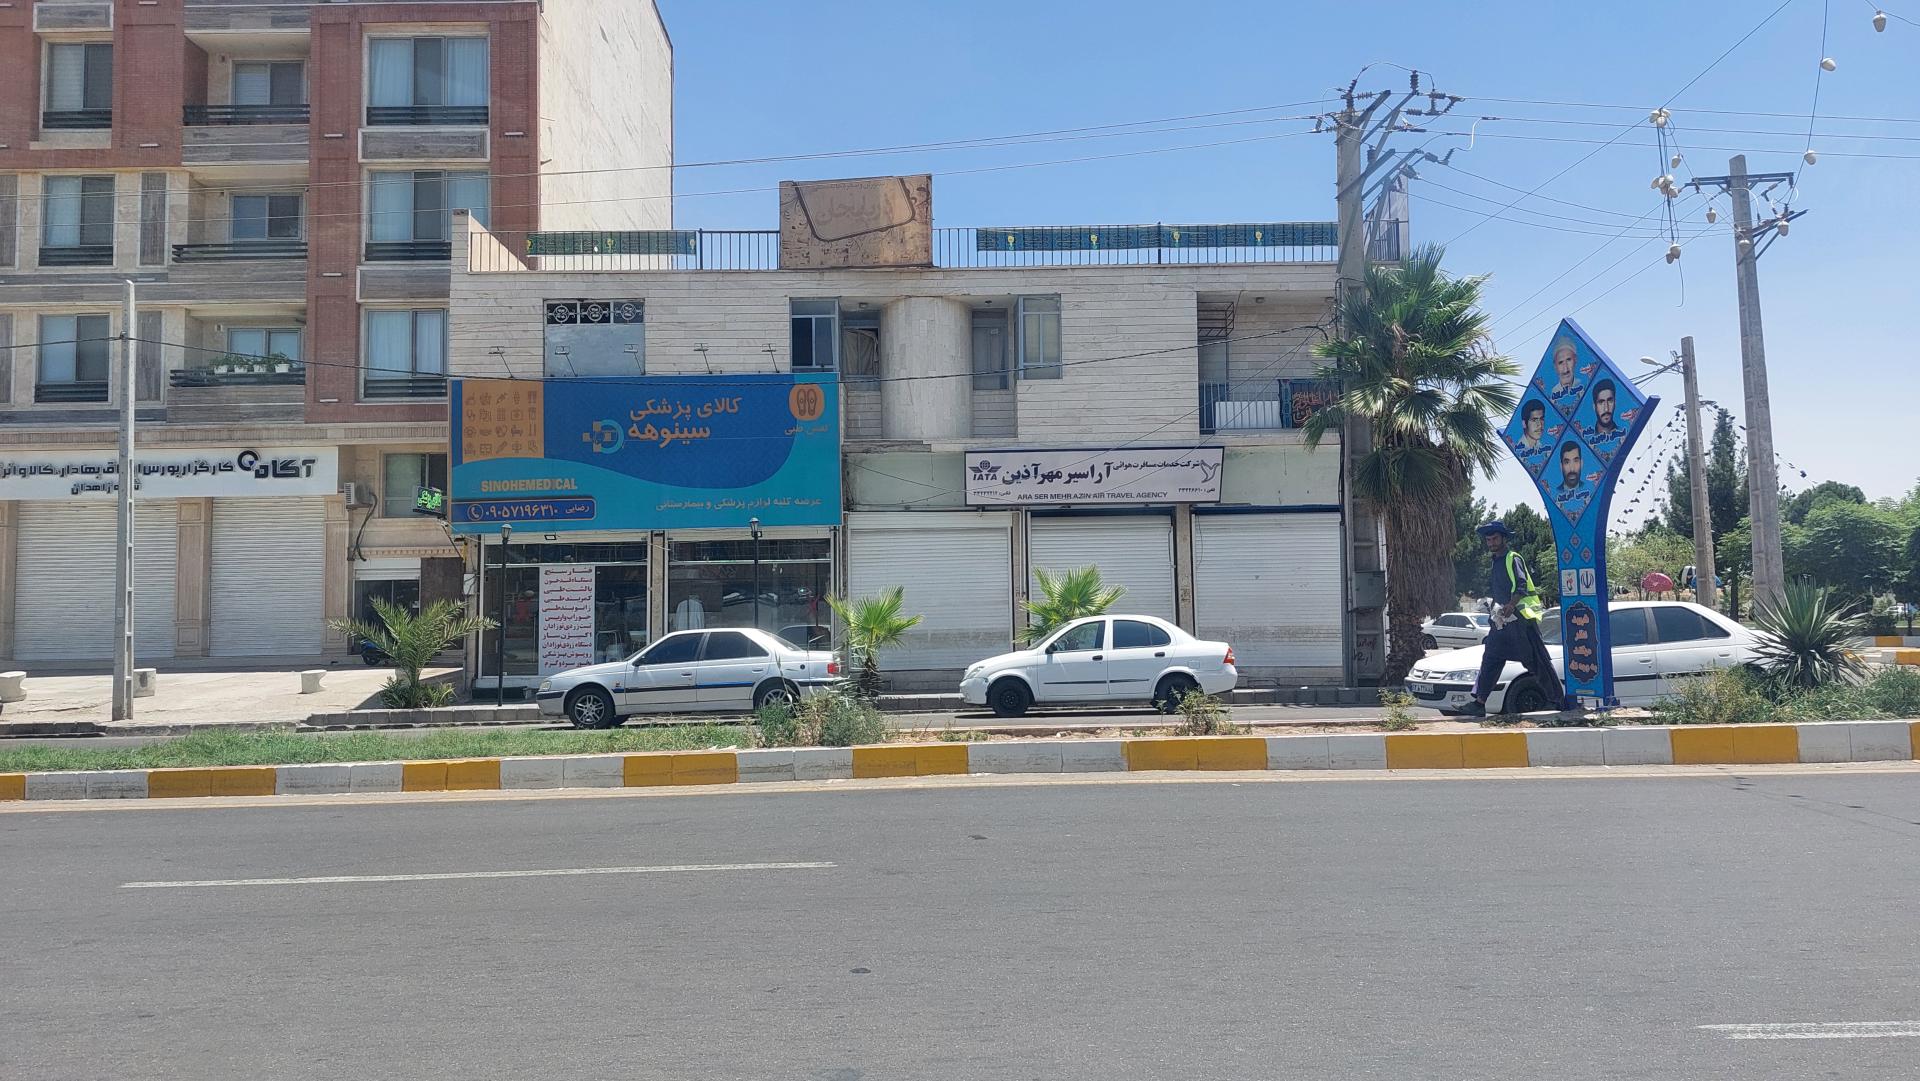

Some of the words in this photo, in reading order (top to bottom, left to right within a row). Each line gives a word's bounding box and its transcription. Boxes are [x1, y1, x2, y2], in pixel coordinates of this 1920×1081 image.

[630, 397, 691, 421] پزشکی
[697, 397, 743, 418] کالای
[628, 423, 710, 449] سینوهه
[29, 464, 54, 476] کالا
[102, 460, 141, 475] ااق
[143, 462, 182, 479] بورس
[254, 458, 316, 479] آگاه
[1133, 460, 1157, 470] مسافرت
[1157, 460, 1180, 470] خدمات
[1180, 459, 1200, 470] شرکت
[973, 473, 997, 481] IATA
[1002, 462, 1042, 485] آذین
[1037, 469, 1063, 485] مهر
[1063, 468, 1089, 485] سیر
[71, 482, 114, 496] زاهدان
[481, 478, 578, 492] SINOHEMEDICAL
[746, 496, 771, 511] لوازم
[773, 496, 792, 506] کلیه
[1017, 494, 1034, 502] ARA
[1035, 493, 1049, 502] SER
[1050, 493, 1072, 501] MEHR
[1072, 492, 1092, 501] AZIN
[1092, 492, 1105, 500] AIR
[1106, 491, 1135, 500] TRAVEL
[1135, 491, 1168, 499] AGENCY
[486, 504, 559, 519] ۰۹۰۵۷۱۹۶۳۱۰
[565, 503, 591, 515] رضایی
[714, 497, 746, 512] پزشکی
